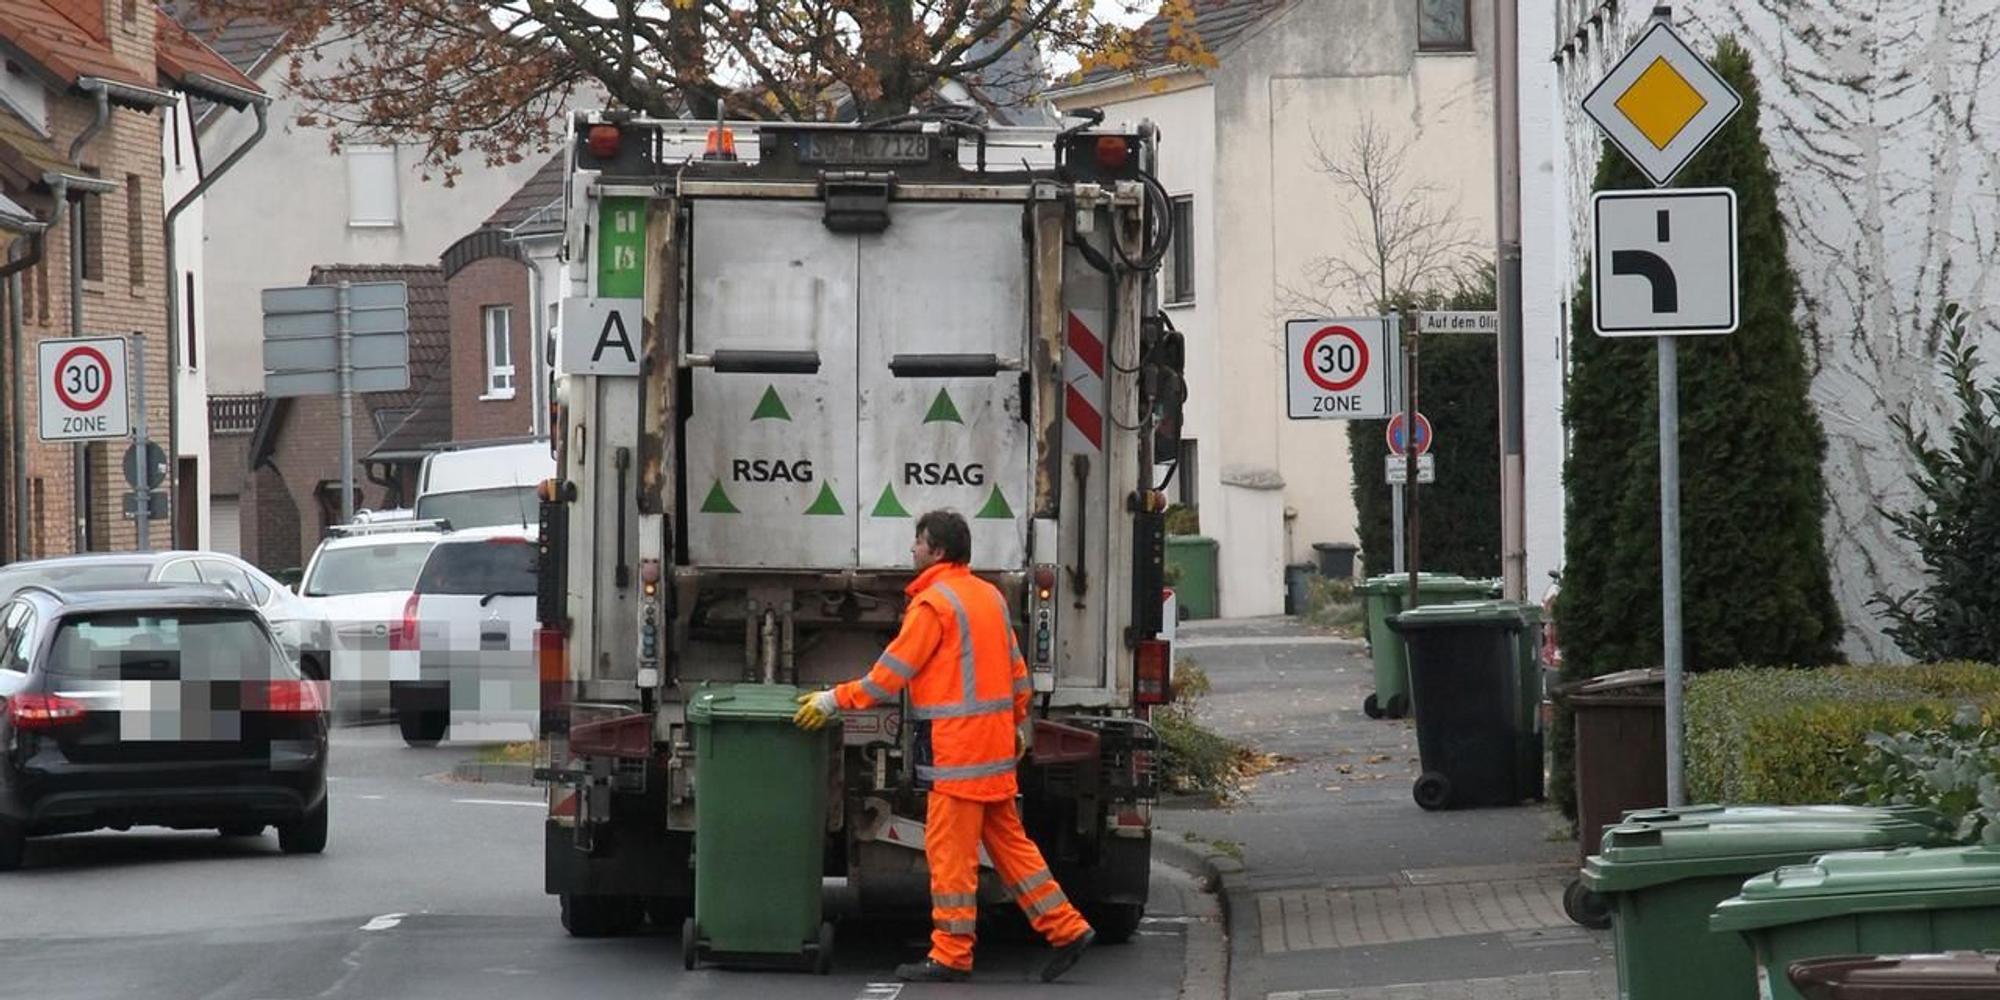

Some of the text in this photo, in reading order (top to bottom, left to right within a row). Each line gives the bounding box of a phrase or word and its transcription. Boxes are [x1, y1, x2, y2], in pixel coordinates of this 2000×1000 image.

[882, 133, 927, 157] 7128
[1428, 315, 1447, 328] Auf
[1451, 315, 1475, 328] dem
[592, 310, 636, 362] A
[1317, 344, 1355, 373] 30
[67, 365, 100, 394] 30
[1313, 395, 1362, 412] ZONE
[63, 415, 107, 433] ZONE
[732, 459, 813, 482] RSAG
[904, 463, 985, 486] RSAG
